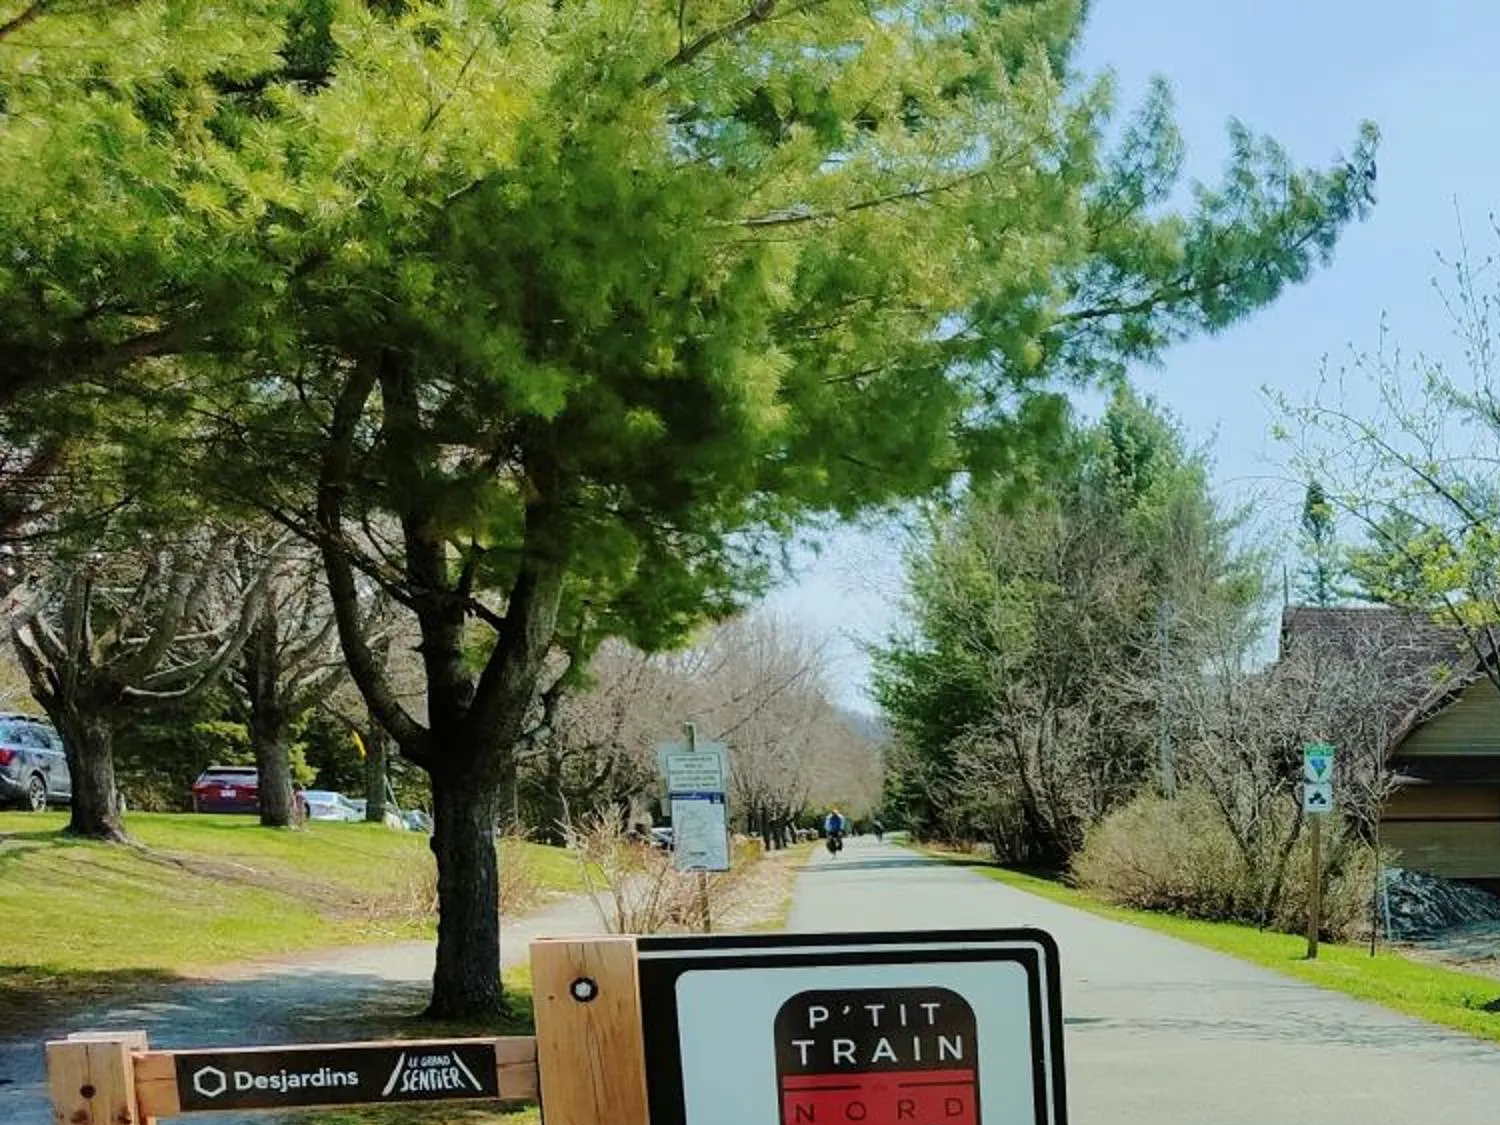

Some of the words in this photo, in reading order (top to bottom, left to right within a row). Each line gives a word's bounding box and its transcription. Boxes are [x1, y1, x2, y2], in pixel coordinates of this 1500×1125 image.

[808, 1003, 941, 1030] P'TIT
[791, 1035, 963, 1066] TRAIN
[233, 1068, 359, 1092] Desjardins
[795, 1098, 965, 1124] NORD
